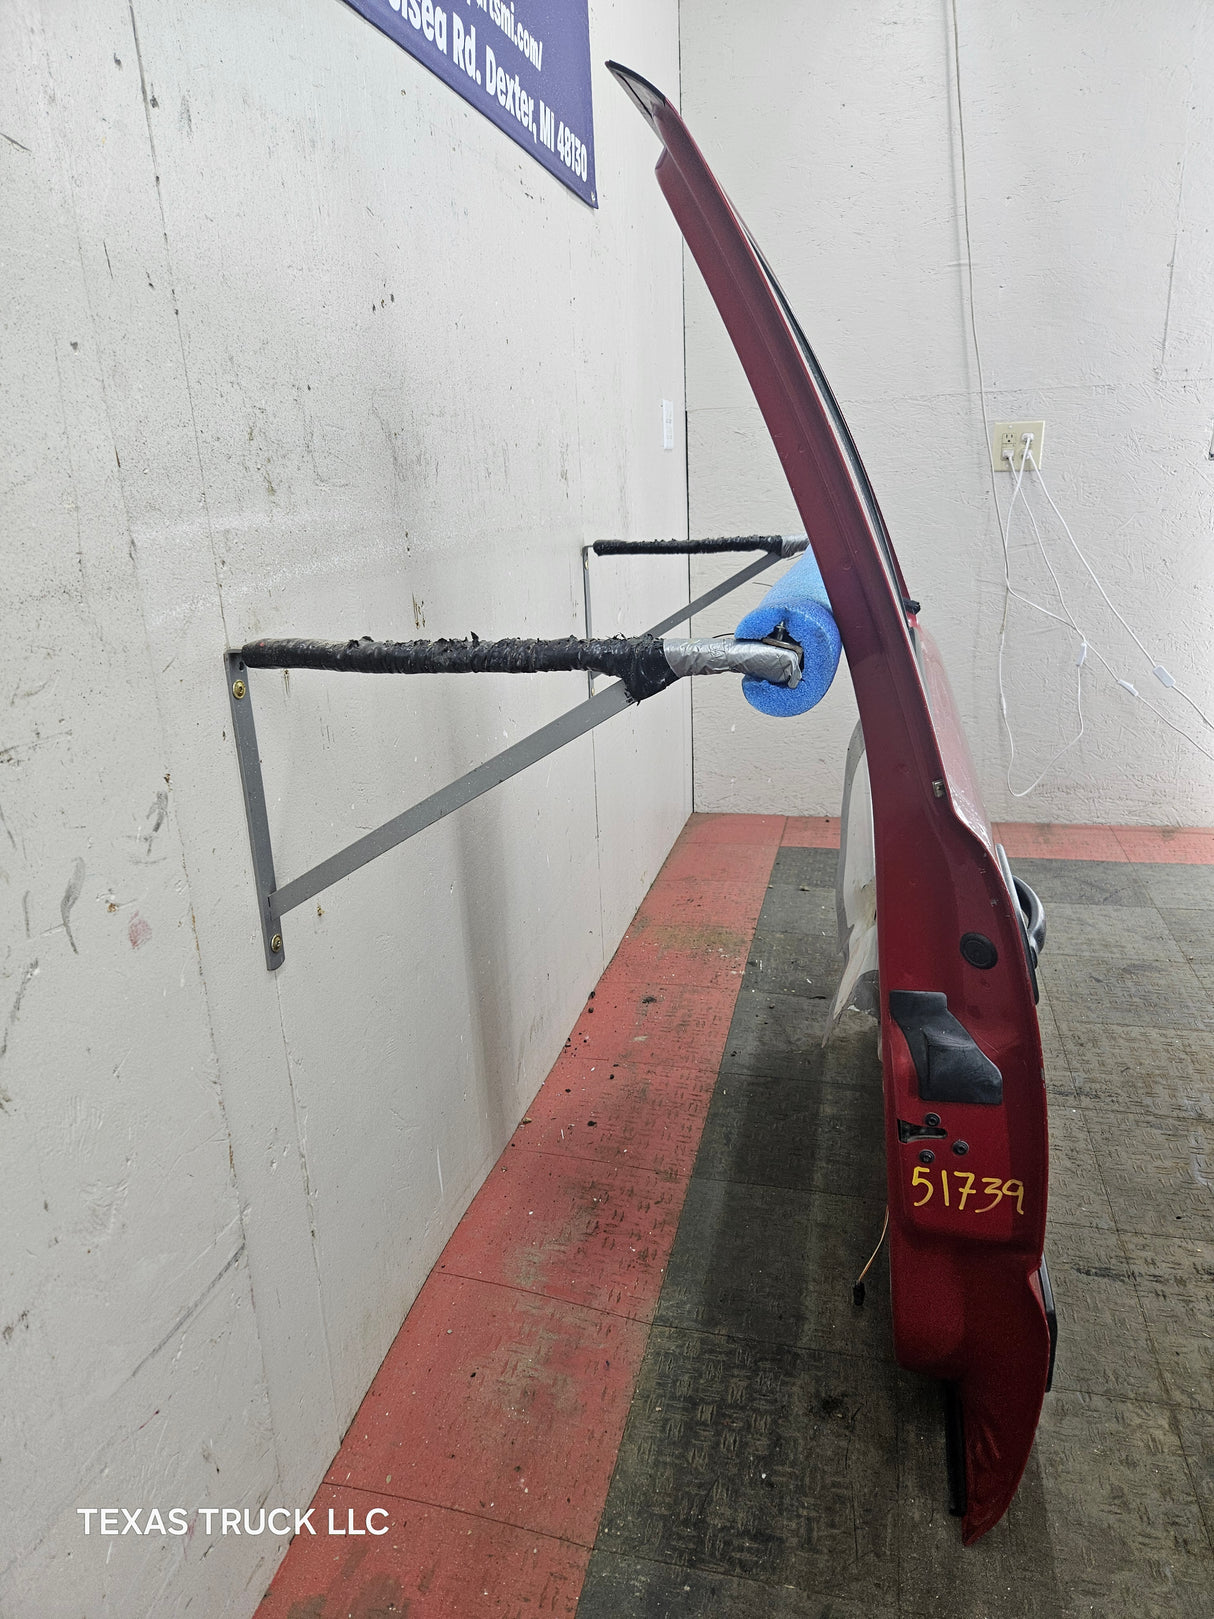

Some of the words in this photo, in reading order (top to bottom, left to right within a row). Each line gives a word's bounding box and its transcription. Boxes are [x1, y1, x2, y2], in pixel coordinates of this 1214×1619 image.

[452, 11, 482, 85] Rd.
[485, 44, 537, 144] Dexter,
[539, 99, 556, 153] MI
[556, 121, 586, 183] 48130
[911, 1166, 1024, 1215] 51739
